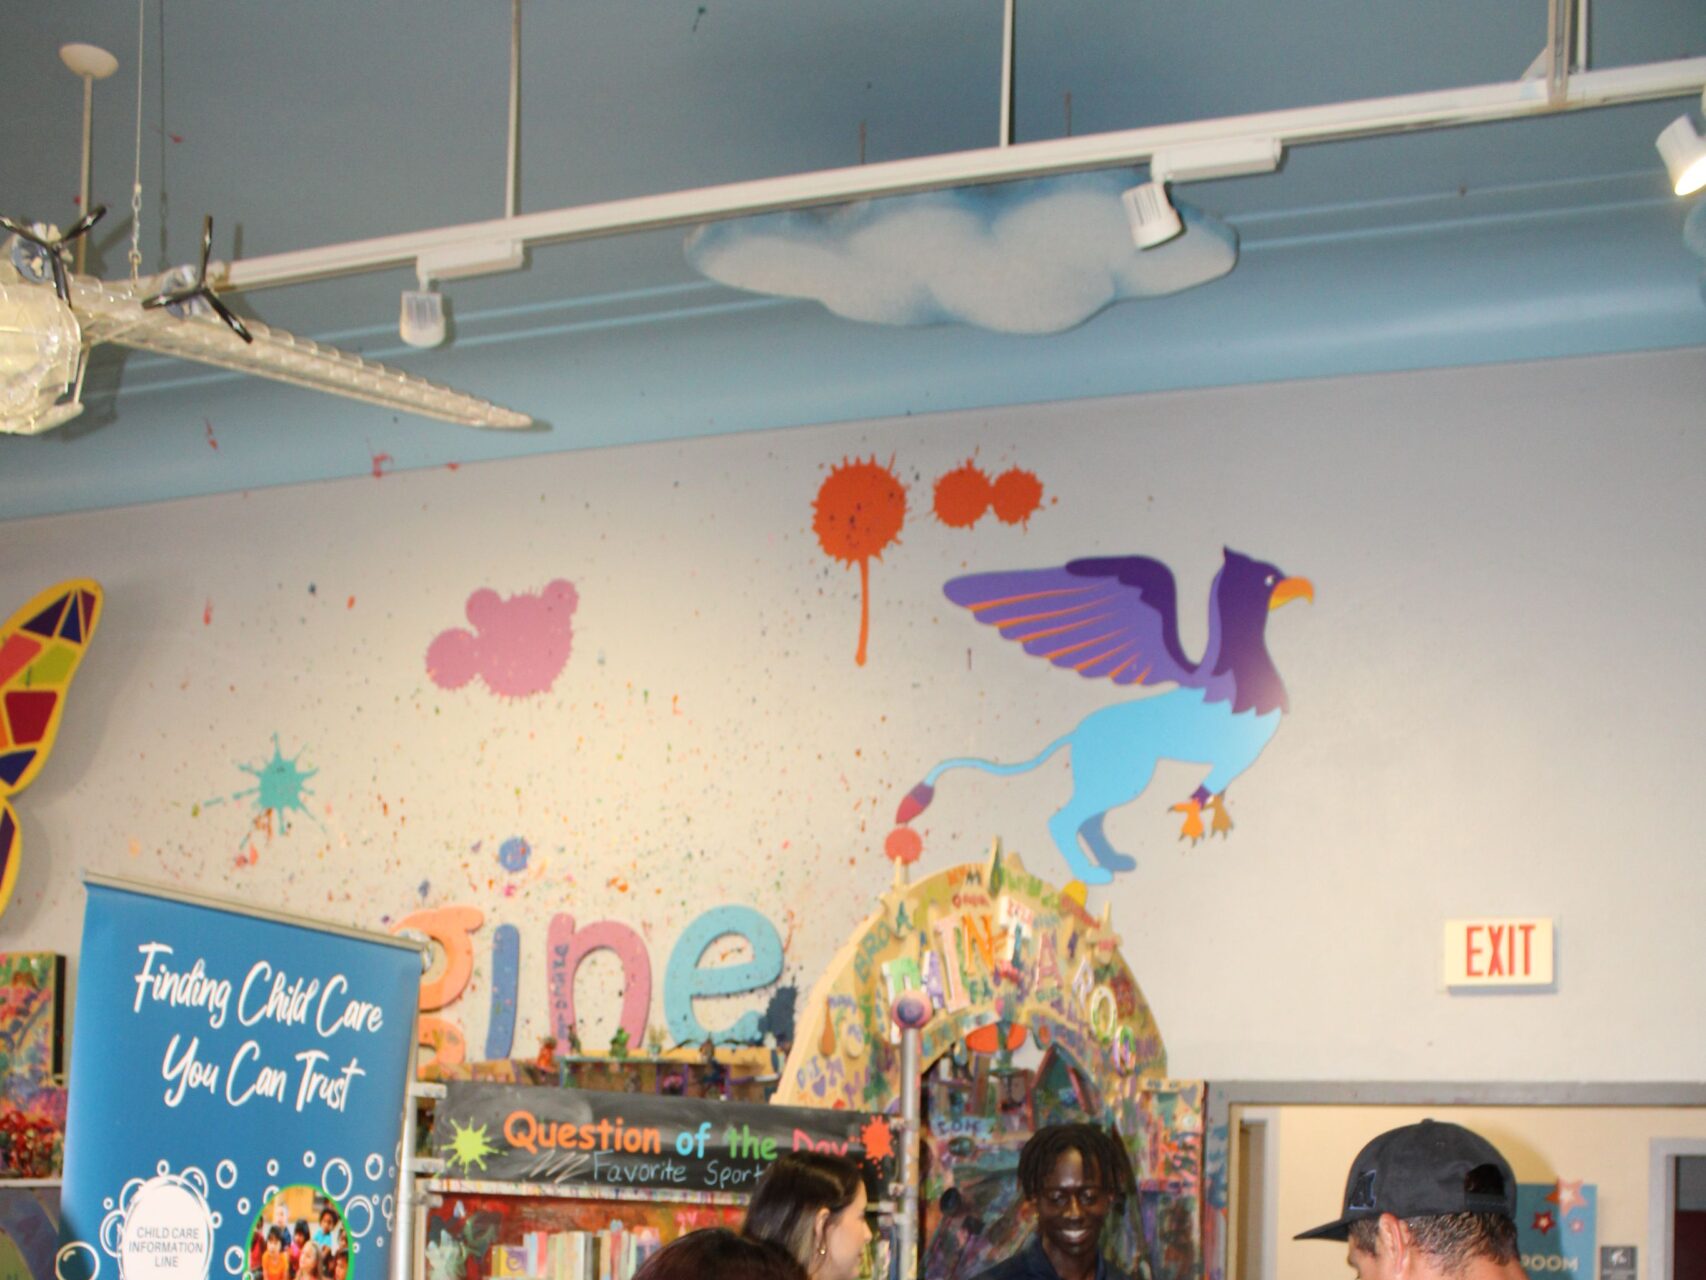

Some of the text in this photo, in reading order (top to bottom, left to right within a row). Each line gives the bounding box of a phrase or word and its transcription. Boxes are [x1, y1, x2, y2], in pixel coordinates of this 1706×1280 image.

[1465, 923, 1537, 977] EXIT
[134, 941, 384, 1038] Finding Child Care
[162, 1034, 366, 1113] You Can Trust
[503, 1109, 661, 1155] Question
[675, 1121, 712, 1159] of
[727, 1124, 778, 1160] the
[592, 1149, 688, 1185] Favorite
[128, 1241, 203, 1254] INFORMATION
[136, 1226, 200, 1240] CHILD CARE
[154, 1255, 179, 1268] LINE
